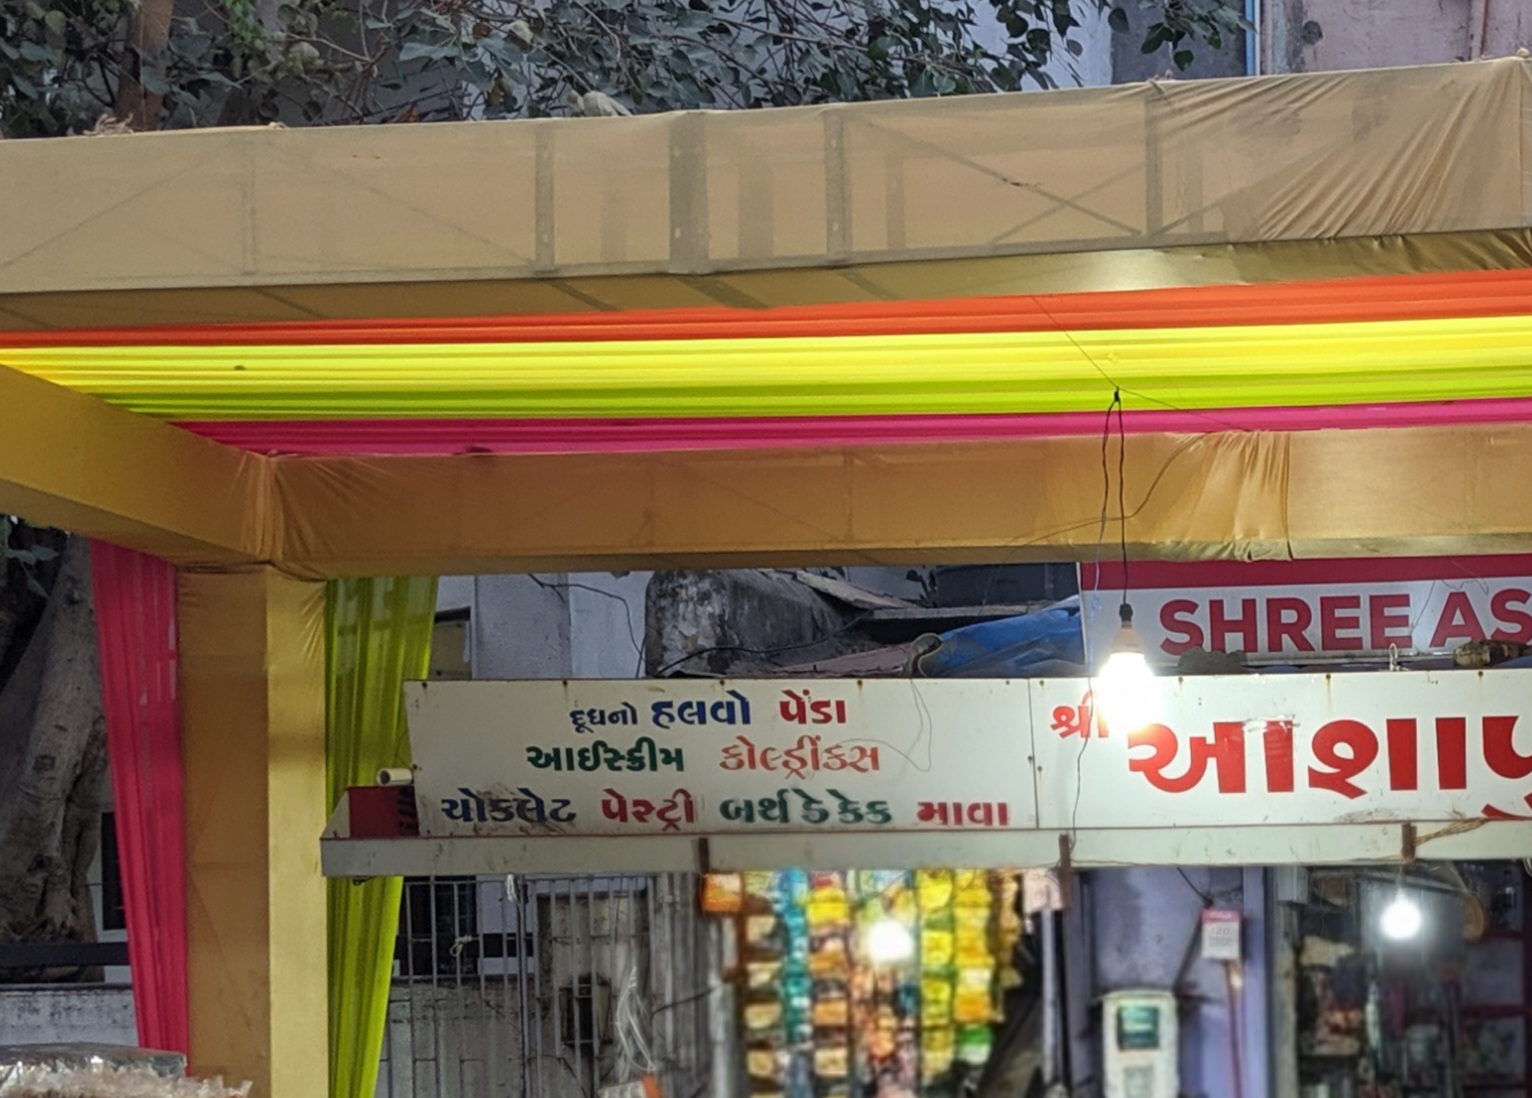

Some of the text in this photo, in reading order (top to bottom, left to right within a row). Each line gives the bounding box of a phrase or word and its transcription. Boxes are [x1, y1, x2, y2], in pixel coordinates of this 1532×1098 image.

[1158, 592, 1413, 655] SHREE
[651, 689, 751, 729] હલવો
[780, 689, 846, 724] પેંડા
[916, 800, 1009, 826] માવા
